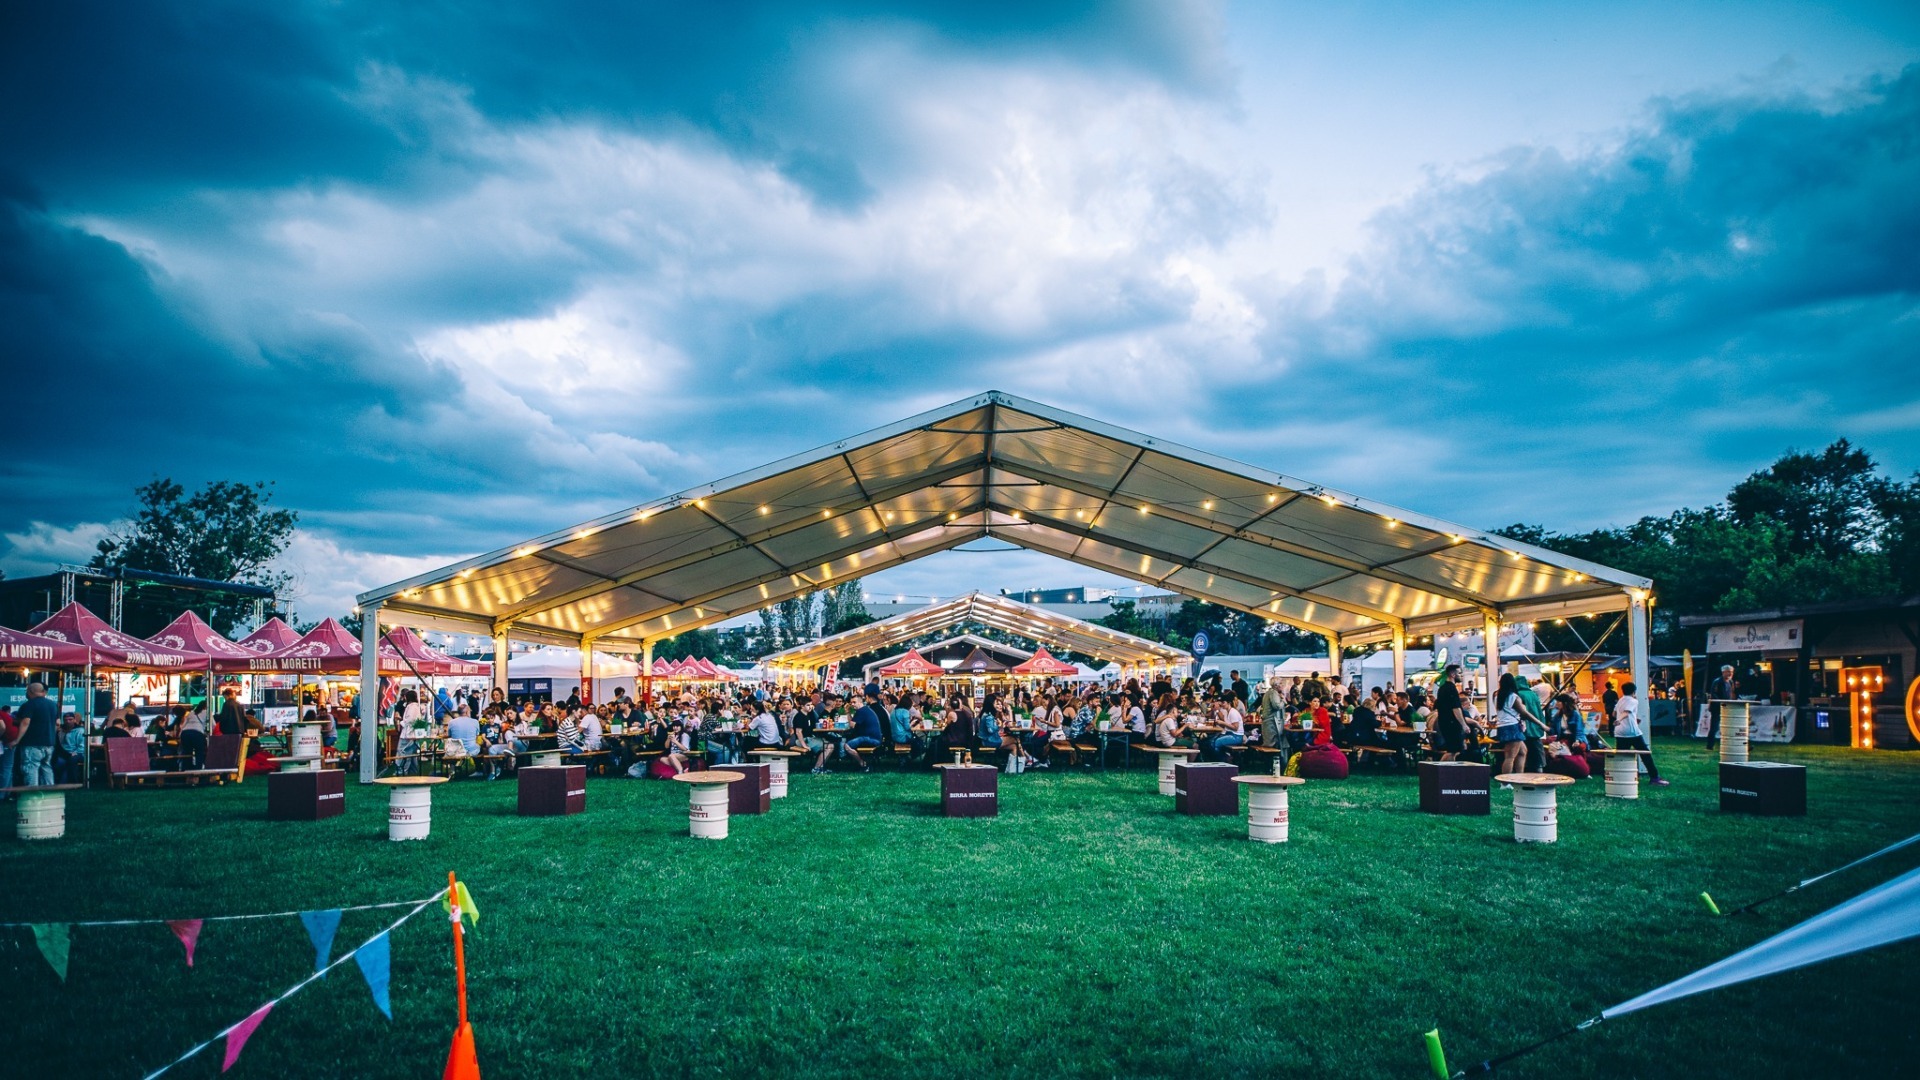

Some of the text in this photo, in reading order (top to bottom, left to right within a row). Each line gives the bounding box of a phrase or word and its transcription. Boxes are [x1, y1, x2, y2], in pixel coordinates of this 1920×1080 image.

[11, 644, 53, 660] MORETTI
[126, 652, 184, 666] BIRRA MORETTI
[250, 657, 322, 670] BIRRA MORETTI
